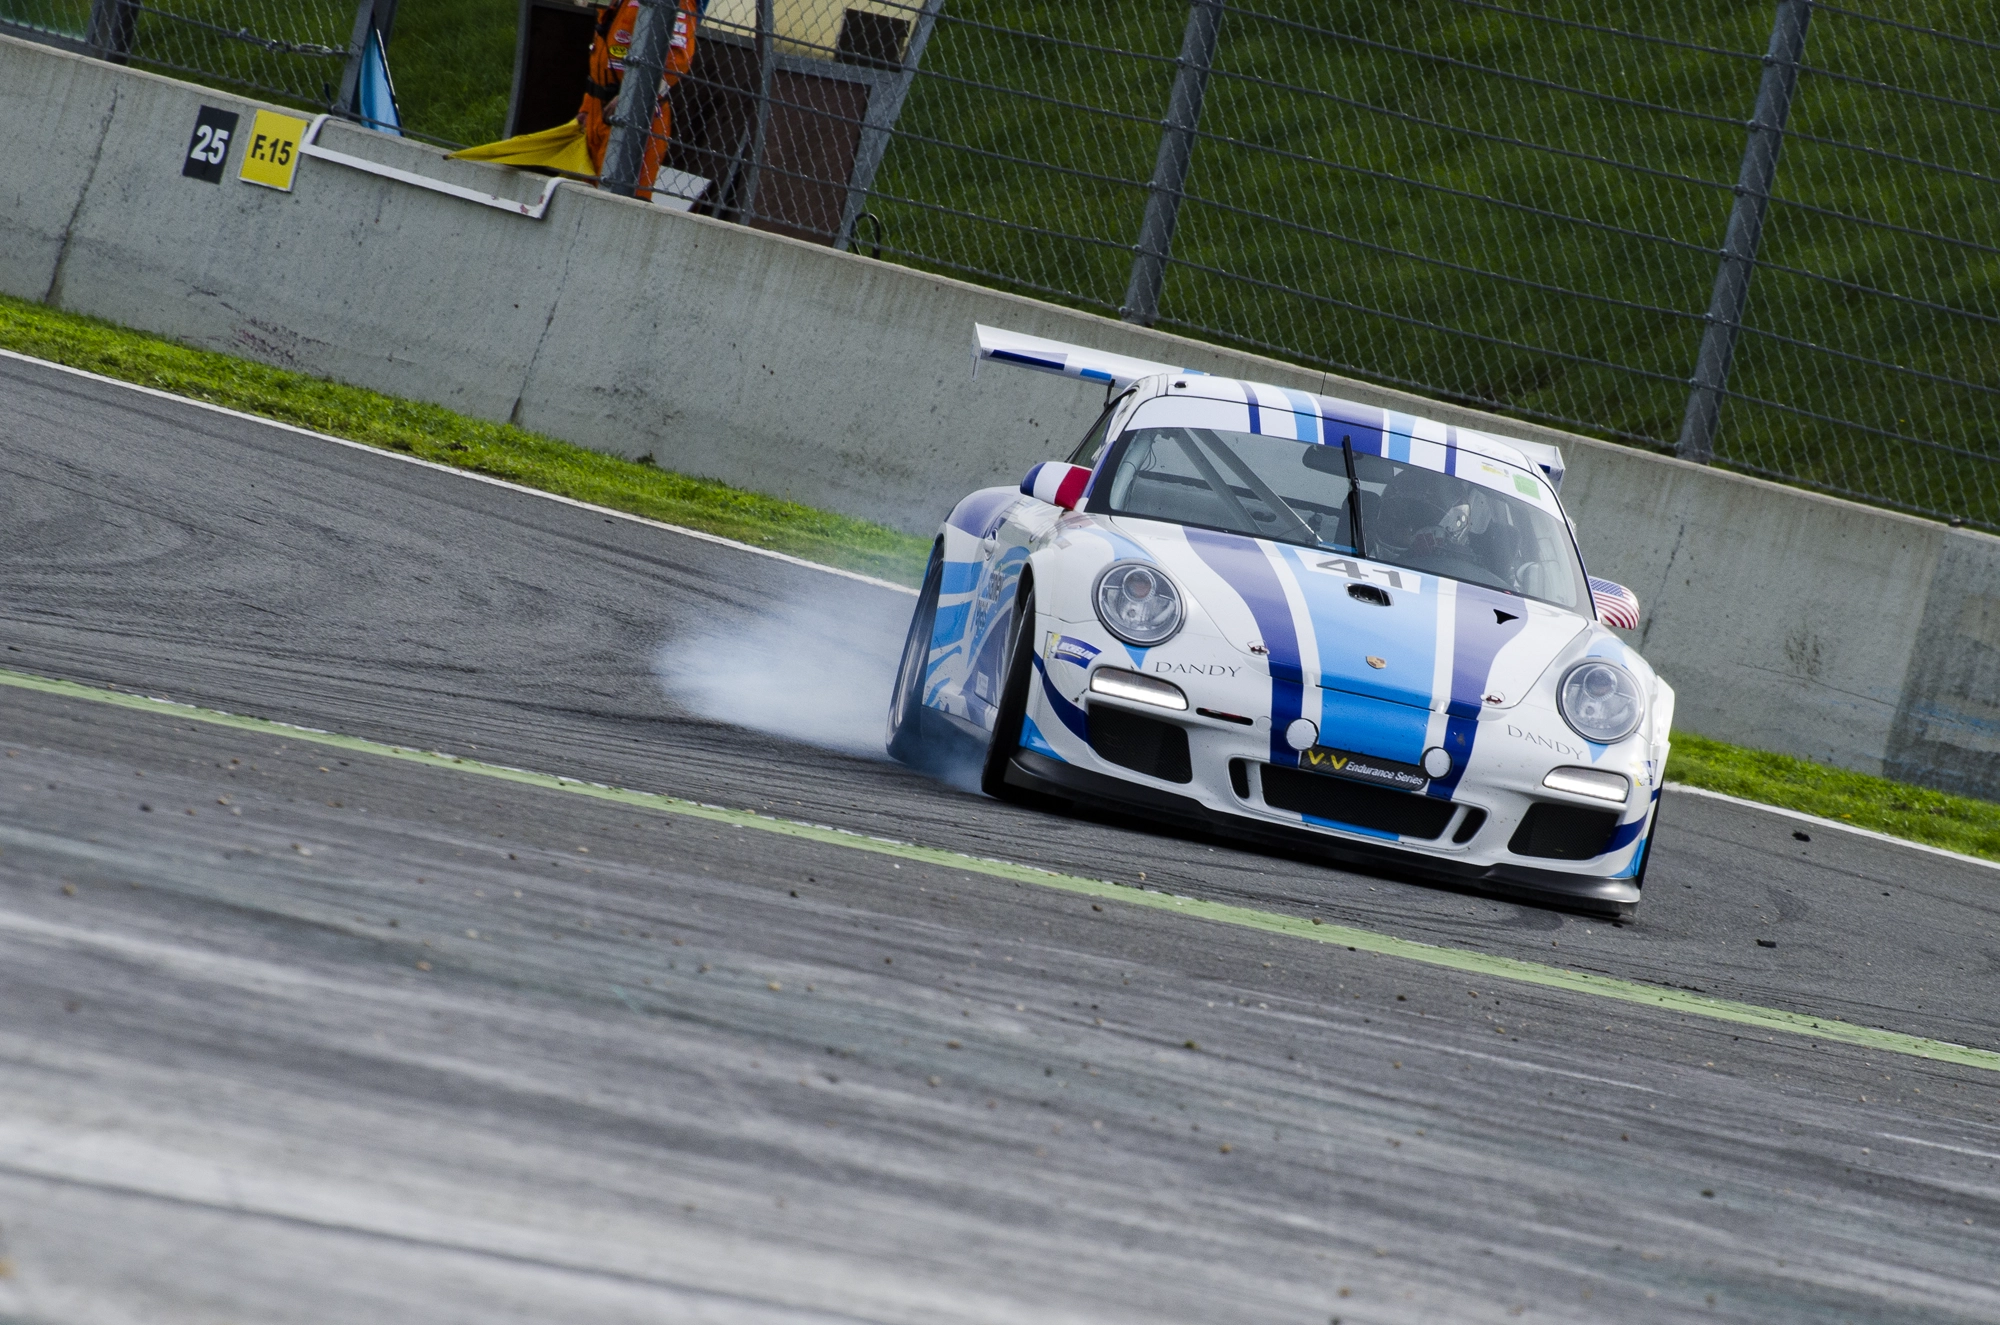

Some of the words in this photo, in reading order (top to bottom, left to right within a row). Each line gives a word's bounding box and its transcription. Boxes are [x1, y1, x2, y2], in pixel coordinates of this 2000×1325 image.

[190, 125, 230, 165] 25
[251, 134, 293, 166] F.15
[1316, 559, 1403, 589] 41
[1155, 661, 1242, 677] DANDY
[1507, 724, 1583, 760] DANDY
[1345, 761, 1395, 779] Endurance
[1395, 771, 1424, 785] Series
